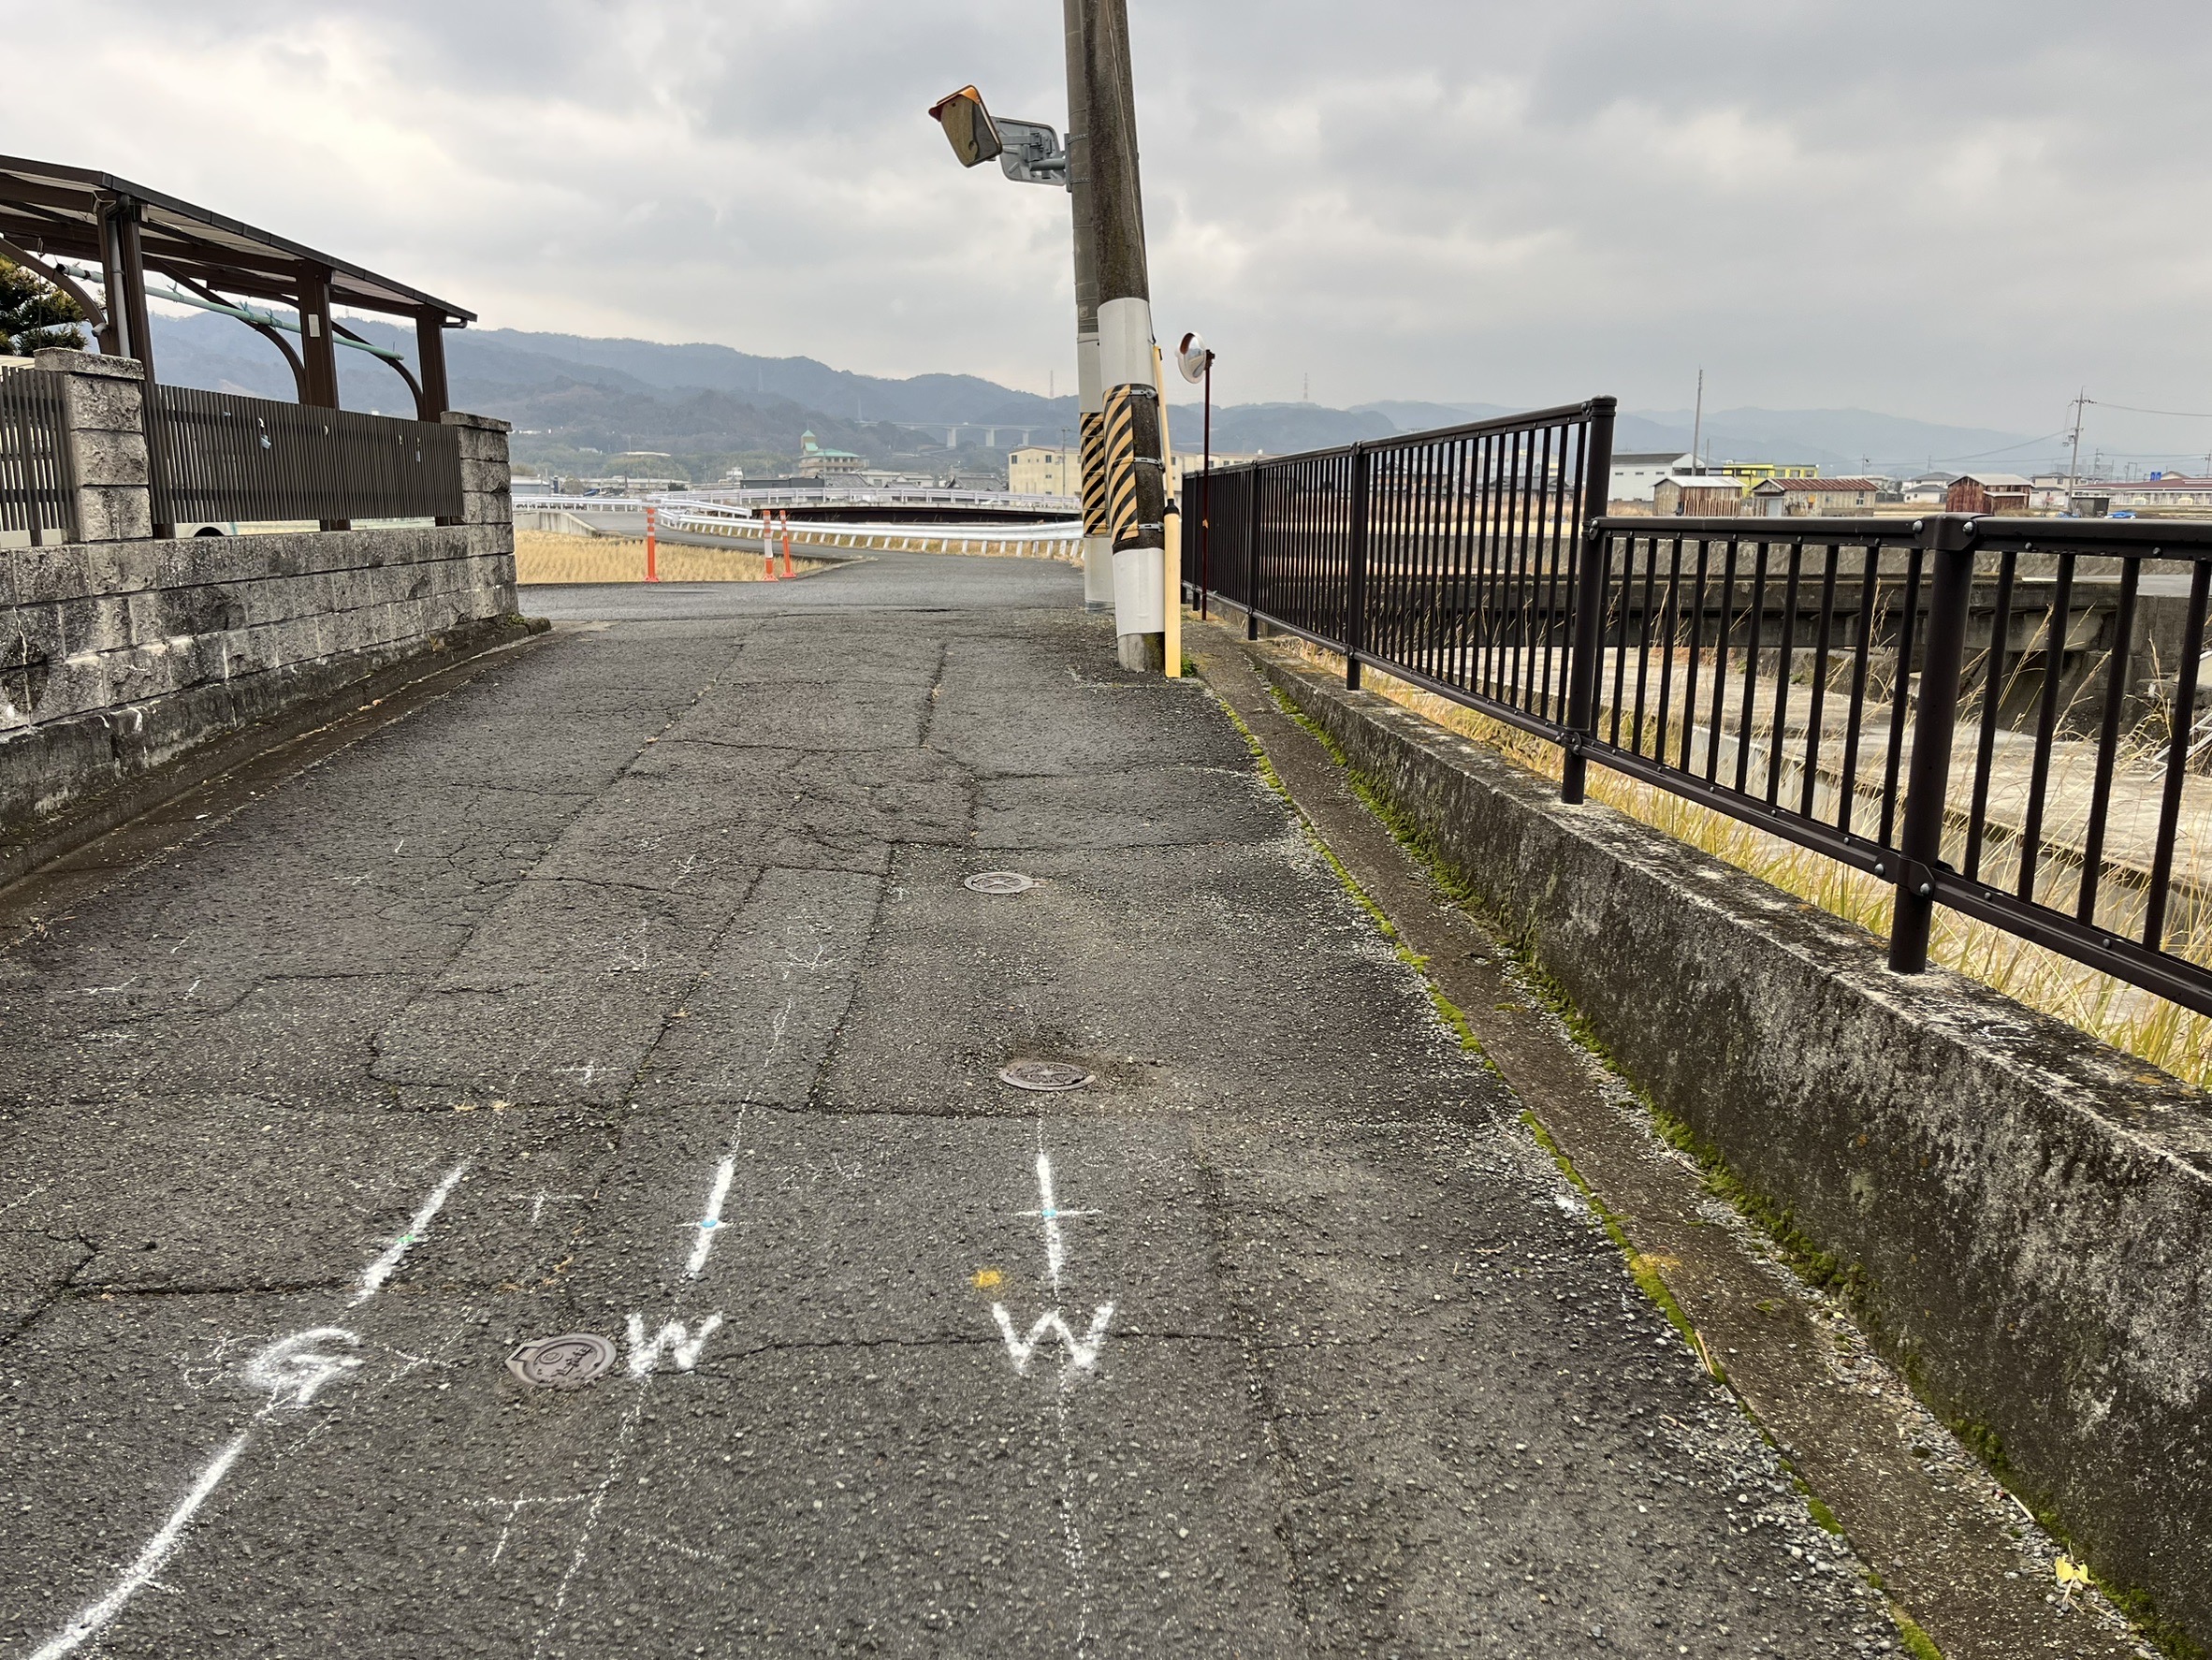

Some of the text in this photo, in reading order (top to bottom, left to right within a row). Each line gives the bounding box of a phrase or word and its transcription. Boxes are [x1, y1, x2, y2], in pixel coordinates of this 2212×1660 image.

[243, 1326, 366, 1405] G
[624, 1311, 723, 1376] W
[992, 1300, 1115, 1374] W
